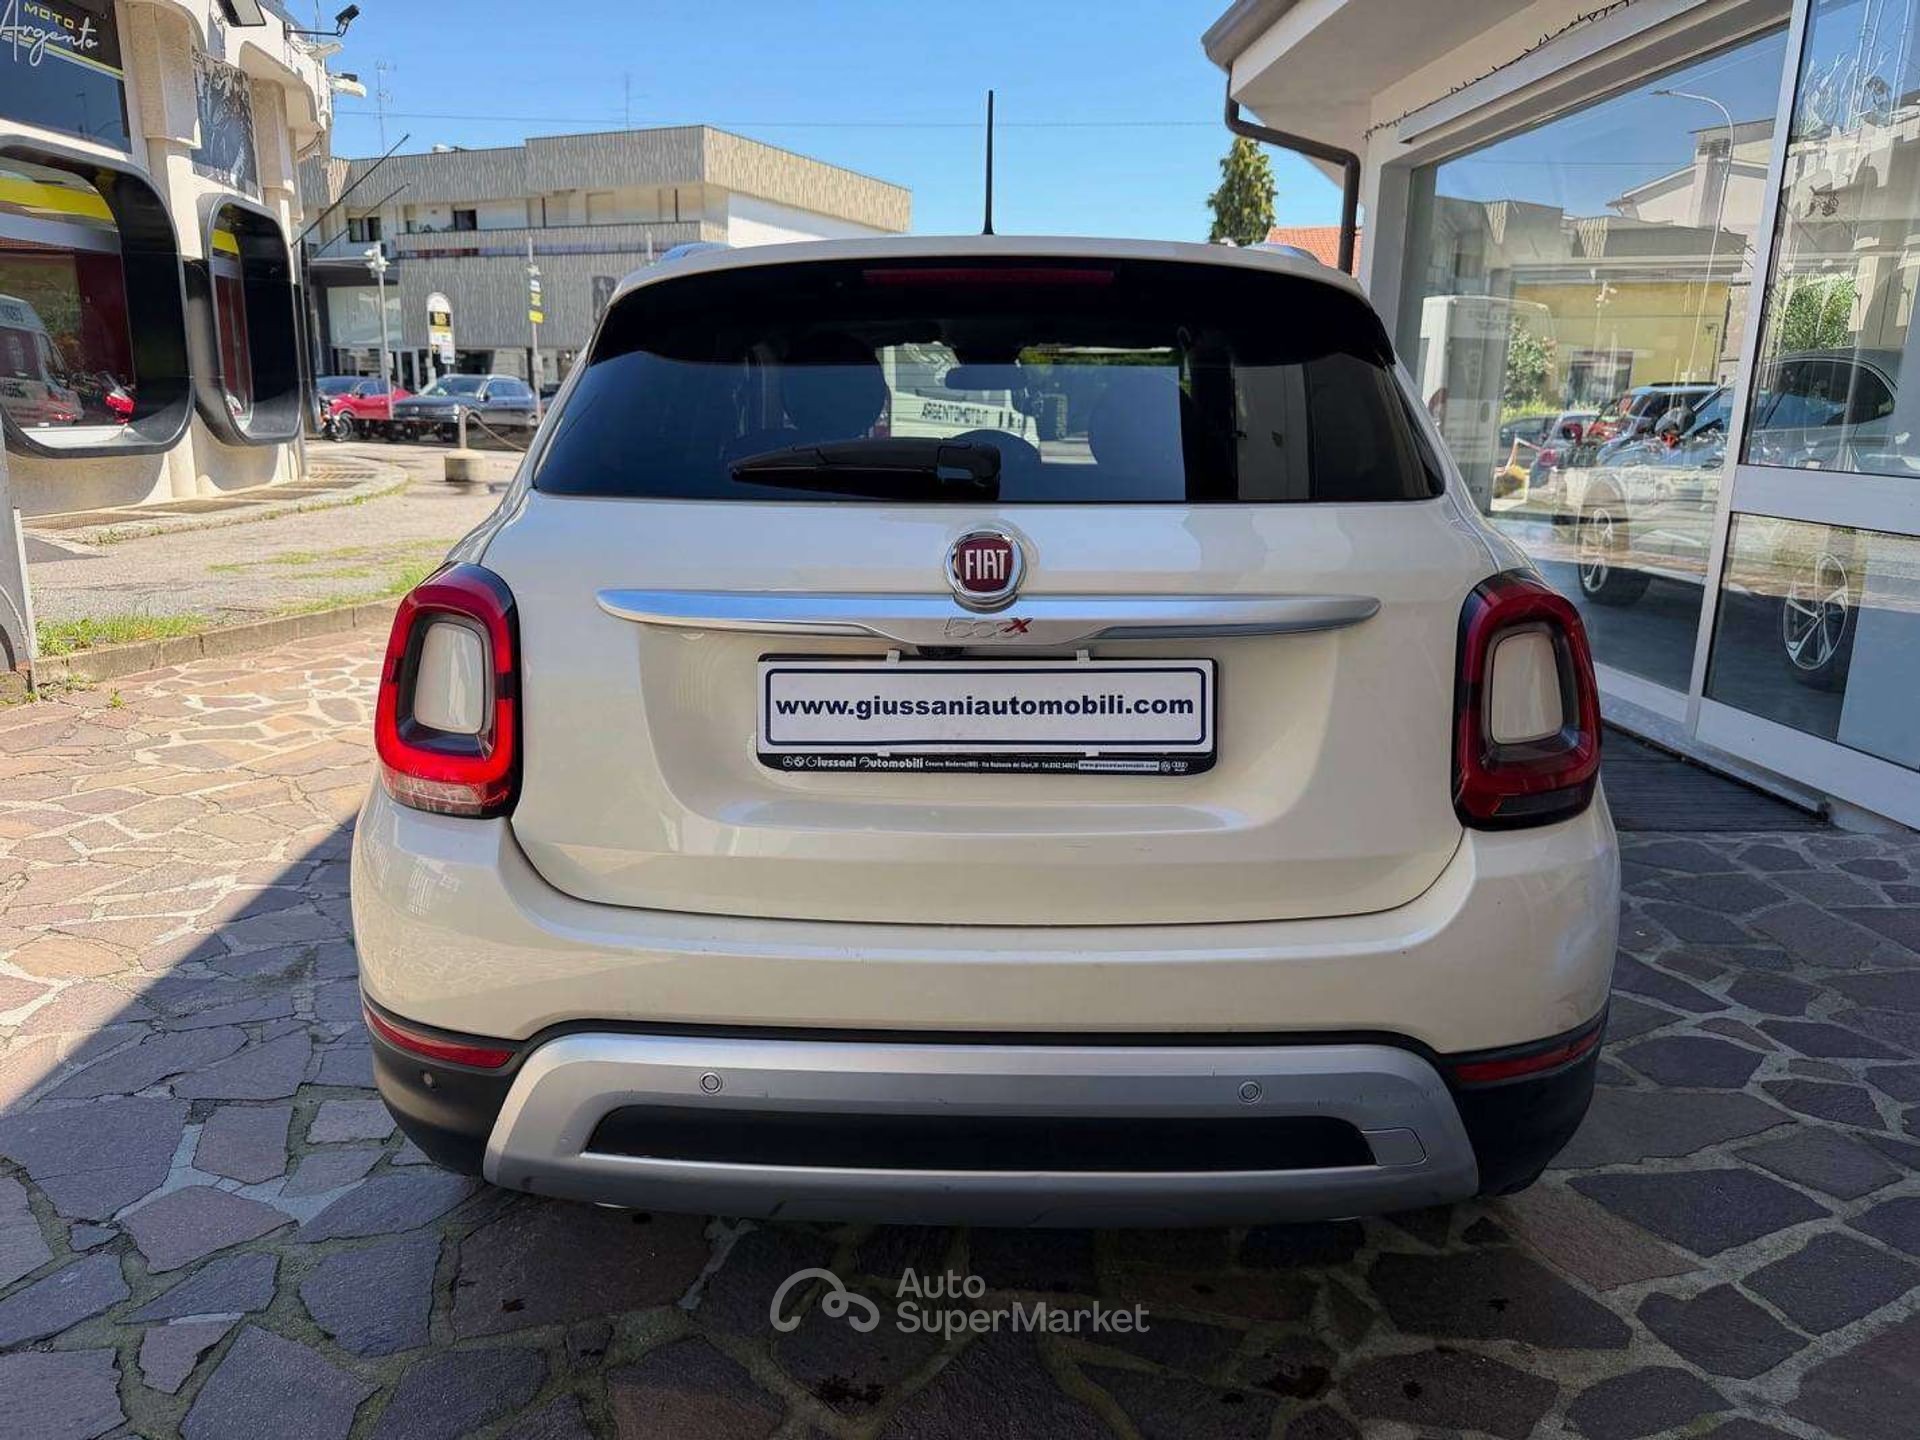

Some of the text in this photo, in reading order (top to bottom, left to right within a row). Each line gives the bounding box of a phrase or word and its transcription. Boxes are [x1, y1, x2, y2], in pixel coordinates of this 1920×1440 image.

[24, 2, 74, 29] MOTO
[0, 0, 98, 67] Argento
[965, 549, 1009, 581] FIAT
[776, 695, 1194, 720] www.giussaniautomobili.com
[805, 756, 857, 769] Giussani
[859, 756, 924, 769] Automobili
